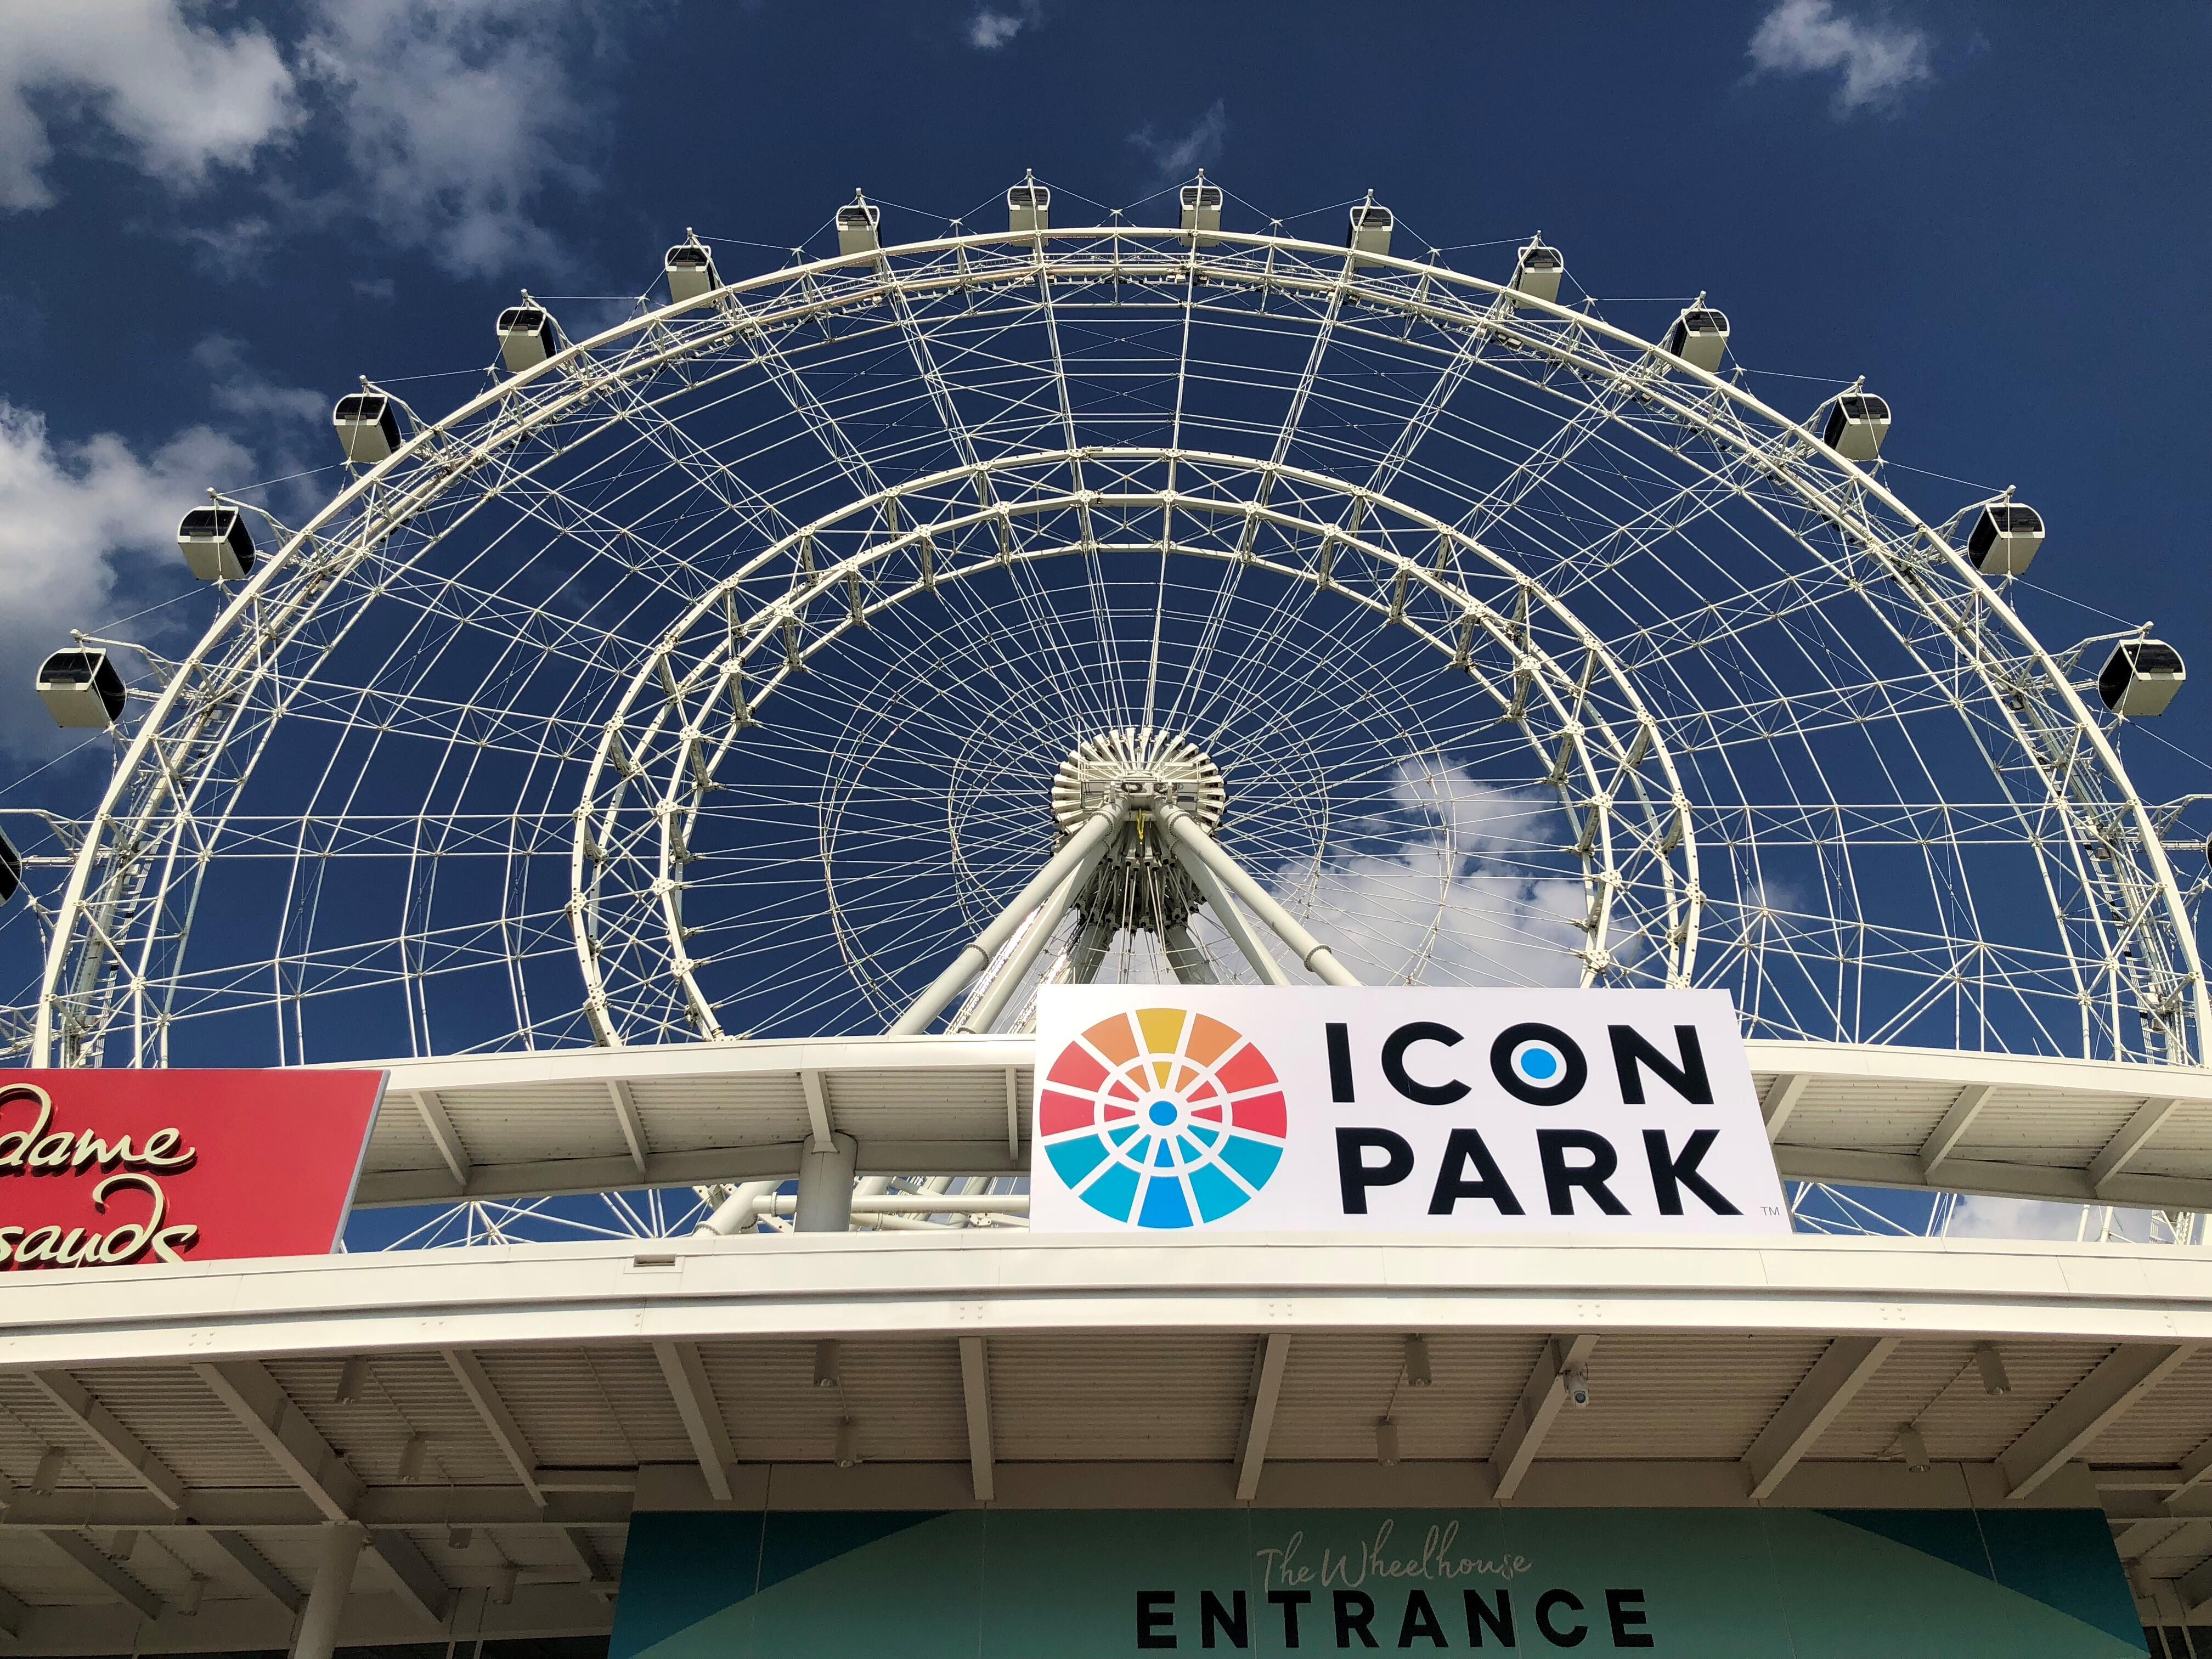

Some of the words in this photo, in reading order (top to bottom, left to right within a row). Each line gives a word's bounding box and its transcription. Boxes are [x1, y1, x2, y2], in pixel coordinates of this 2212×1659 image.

[1325, 1022, 1715, 1107] ICON
[1335, 1127, 1744, 1215] PARK
[1760, 1206, 1780, 1216] TM
[1256, 1531, 1317, 1592] The
[1321, 1519, 1532, 1588] Wheelhouse
[1136, 1588, 1655, 1649] ENTRANCE
